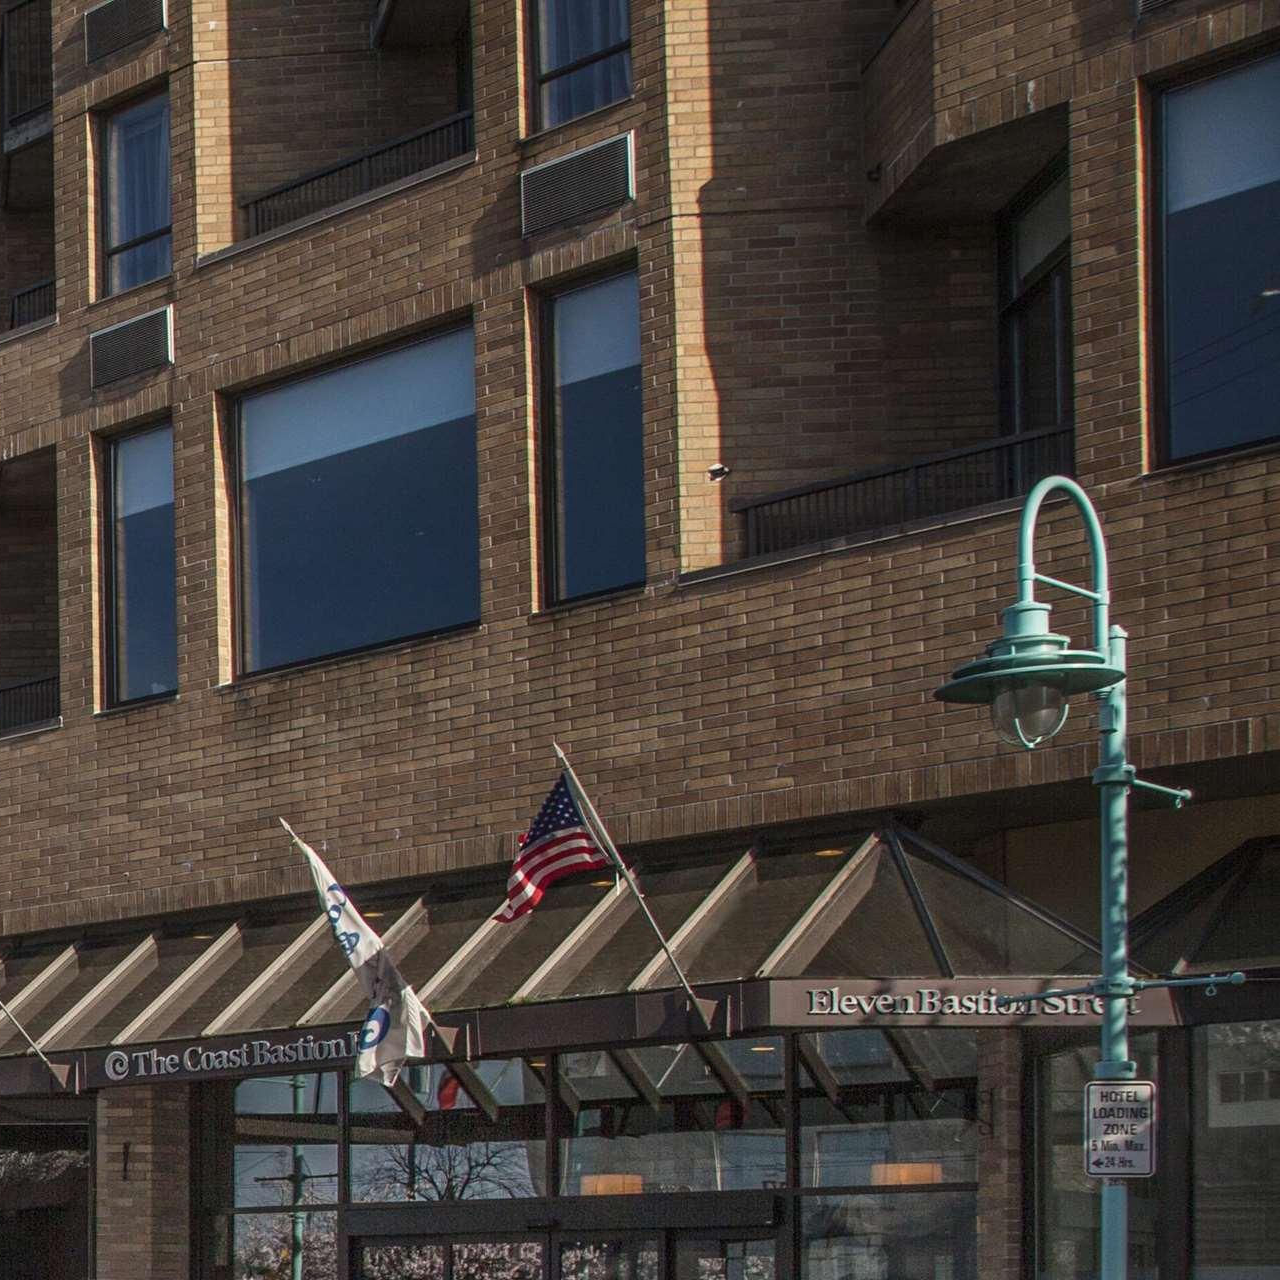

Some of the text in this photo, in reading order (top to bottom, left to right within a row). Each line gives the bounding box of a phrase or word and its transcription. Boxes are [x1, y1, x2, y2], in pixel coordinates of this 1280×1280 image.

[807, 987, 915, 1016] Eleven
[1043, 988, 1142, 1016] Stret
[132, 1050, 180, 1077] The
[183, 1043, 250, 1072] Coast
[250, 1034, 348, 1066] Bastion
[1100, 1091, 1141, 1103] HOTEL
[1093, 1107, 1149, 1119] LOADING
[1103, 1124, 1138, 1136] ZONE
